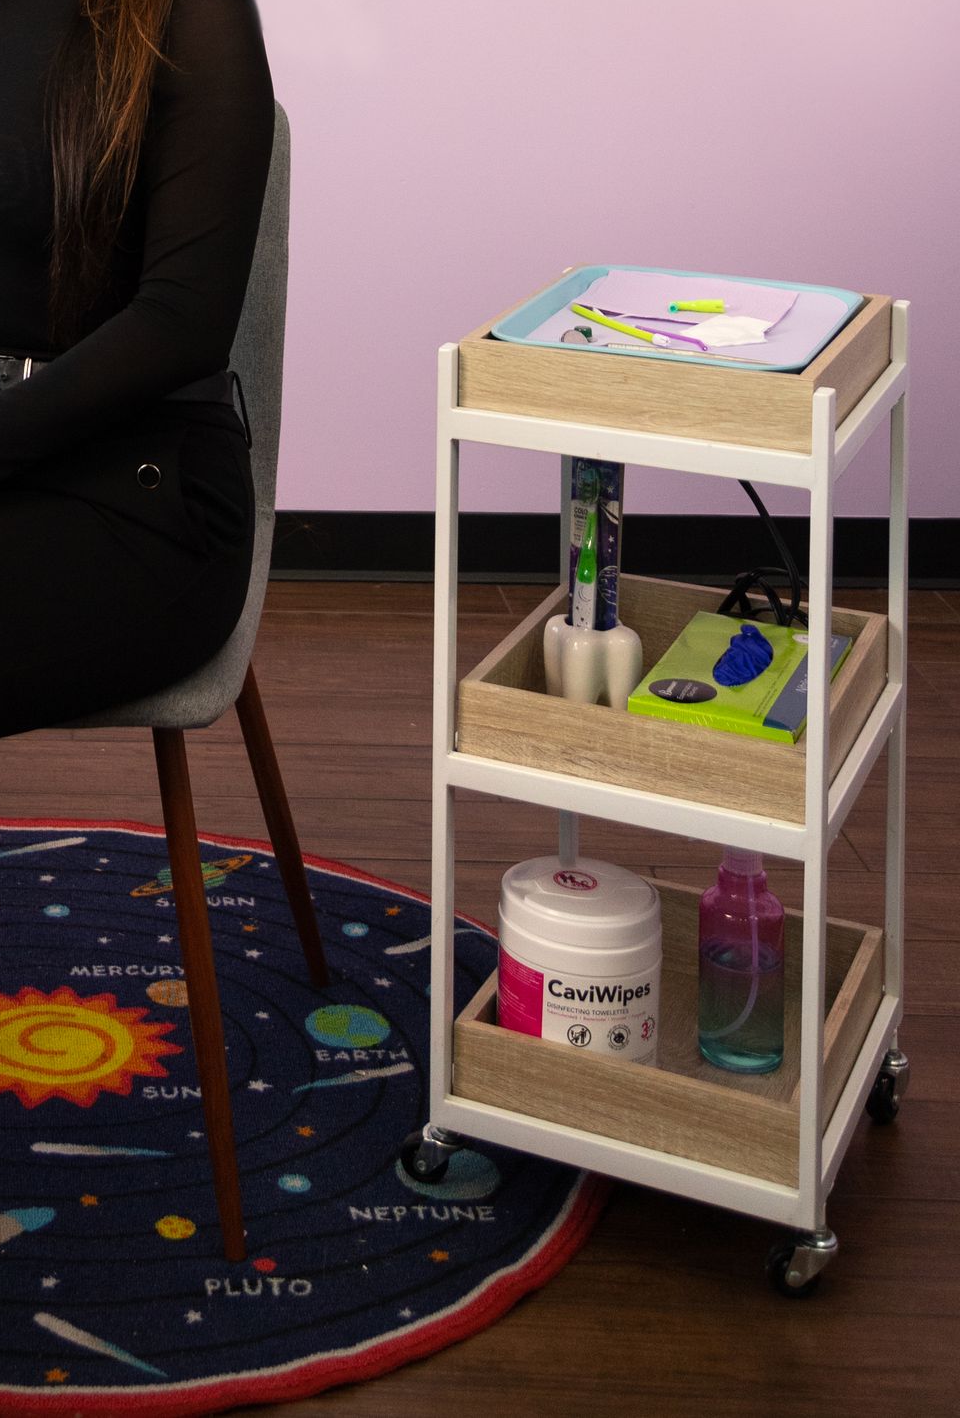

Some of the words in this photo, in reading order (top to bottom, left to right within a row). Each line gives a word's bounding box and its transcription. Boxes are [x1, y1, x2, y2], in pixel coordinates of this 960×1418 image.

[156, 897, 256, 907] SURN
[548, 979, 651, 1006] CaviWipes
[546, 1001, 590, 1015] DISINFECTING
[592, 1008, 629, 1016] TOWELETTES
[315, 1048, 409, 1061] EARTH
[143, 1085, 202, 1099] SUN
[349, 1205, 496, 1222] NEPTUNE
[205, 1278, 312, 1296] PLUTO
